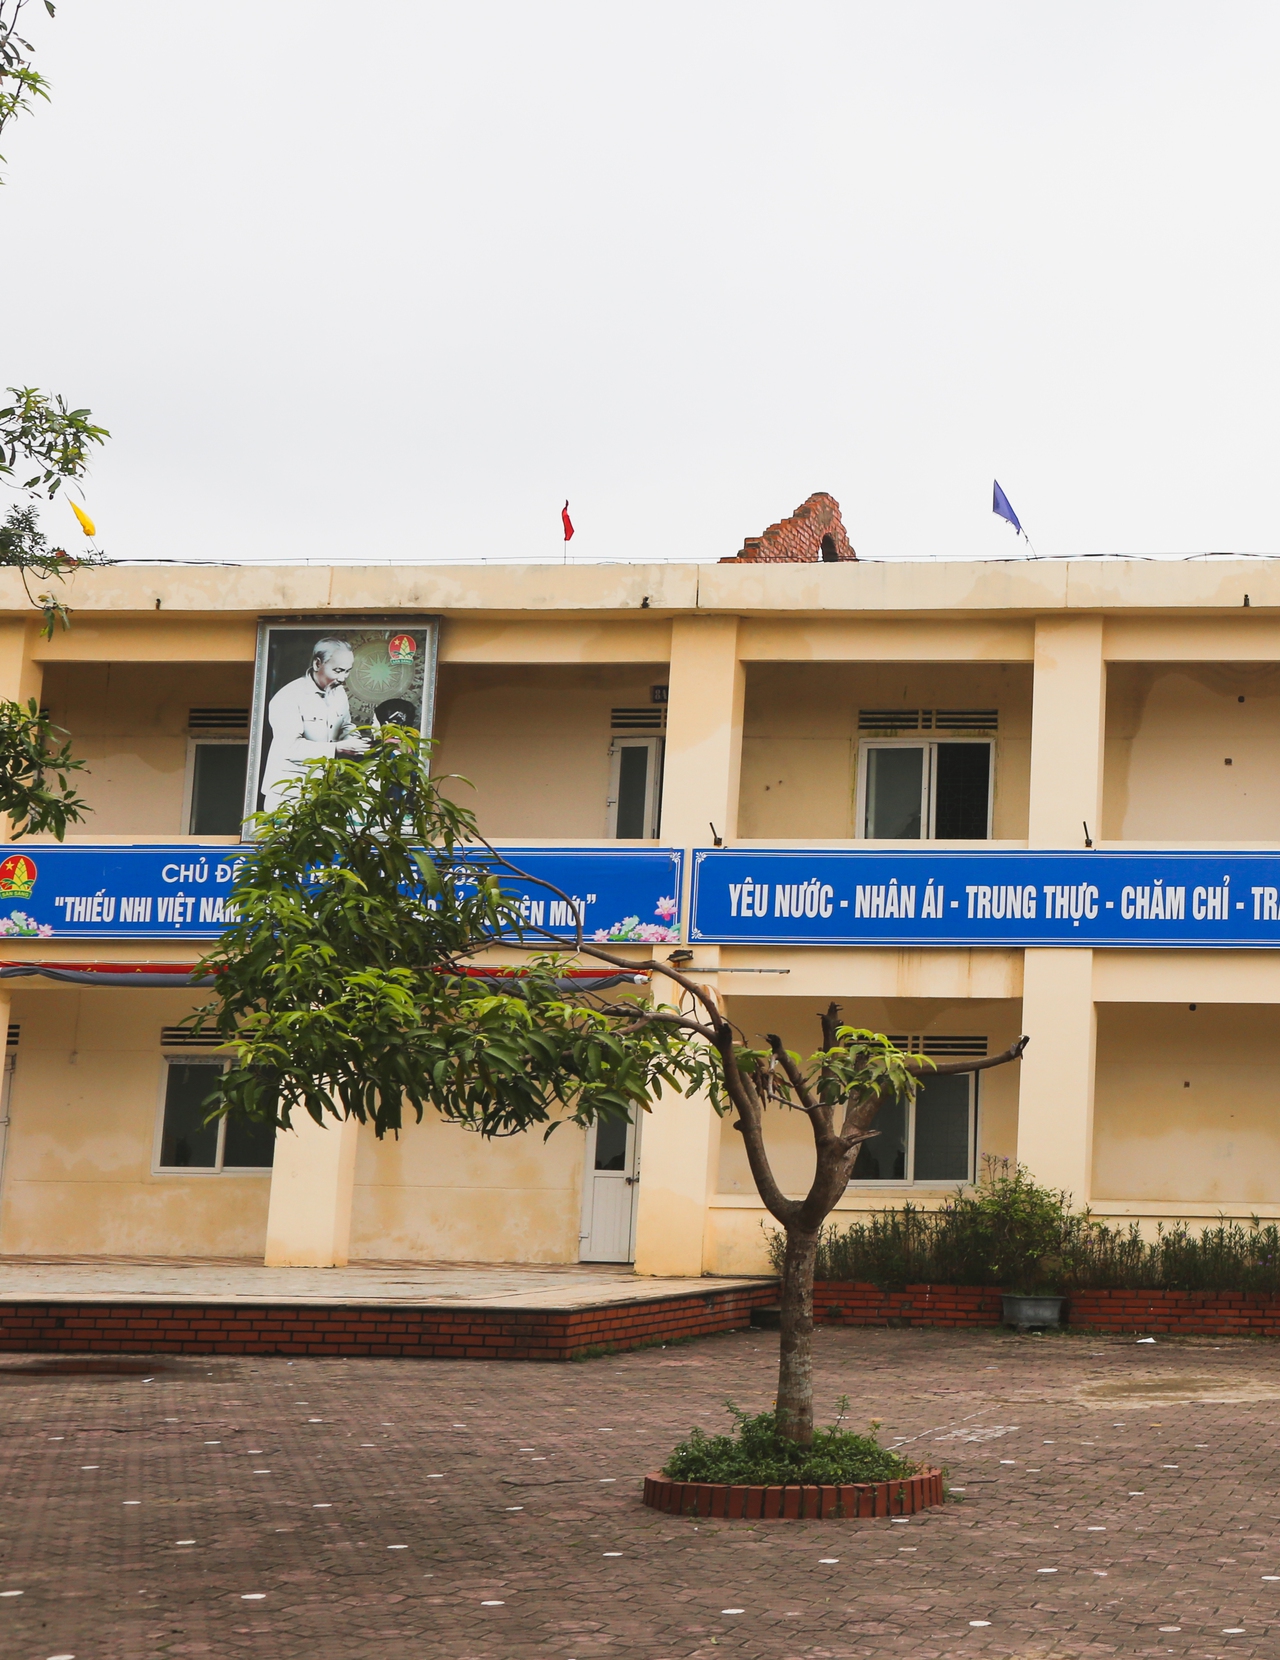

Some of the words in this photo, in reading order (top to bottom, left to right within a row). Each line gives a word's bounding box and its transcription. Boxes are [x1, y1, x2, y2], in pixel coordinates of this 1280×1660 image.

[162, 857, 209, 883] CHỦ
[120, 897, 152, 923] NHI
[158, 891, 196, 928] VIỆT
[200, 897, 242, 923] NAM
[729, 876, 769, 918] YÊU
[775, 877, 834, 919] NƯỚC
[855, 877, 915, 919] NHÂN
[921, 877, 944, 919] ÁI
[966, 885, 1037, 919] TRUNG
[1044, 882, 1099, 927] THỰC
[1121, 879, 1186, 920] CHĂM
[1193, 875, 1231, 921] CHỈ
